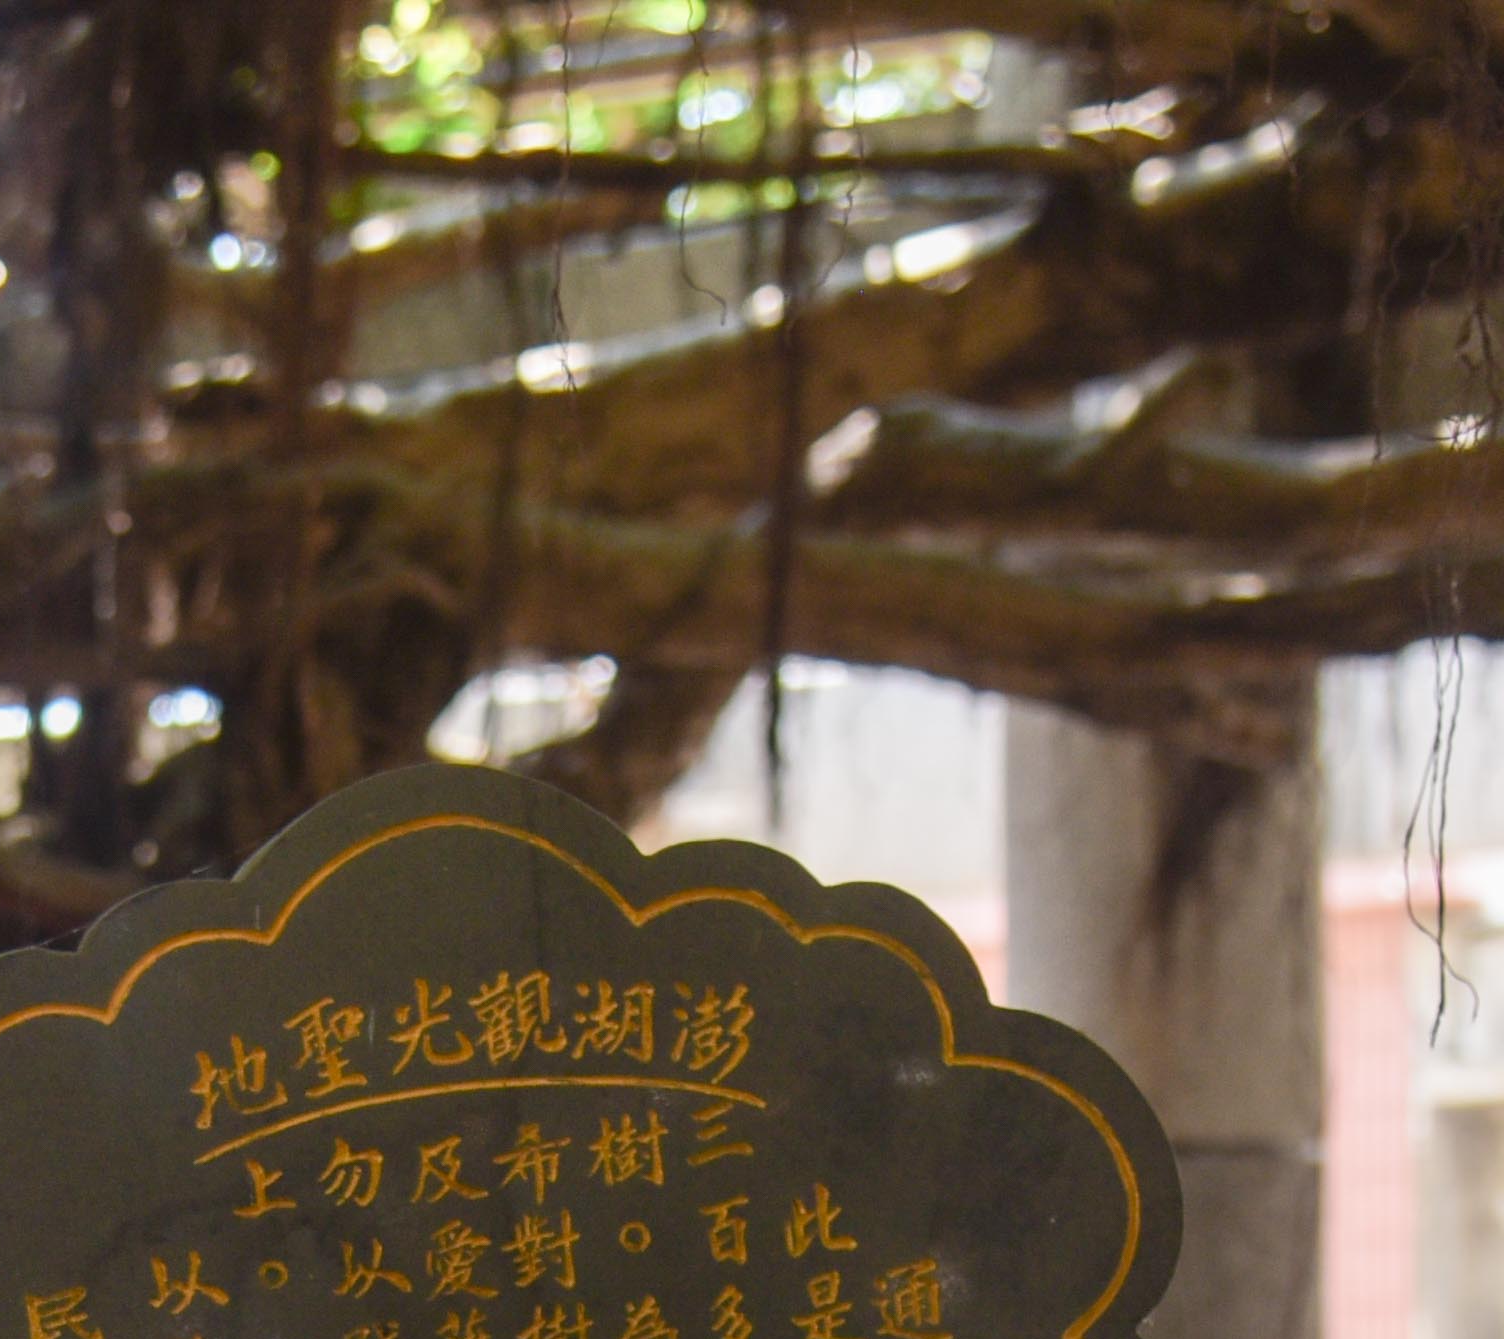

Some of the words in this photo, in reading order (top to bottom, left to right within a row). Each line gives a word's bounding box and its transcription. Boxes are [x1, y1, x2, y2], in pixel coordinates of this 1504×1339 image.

[191, 970, 754, 1130] 澎湖觀光聖地
